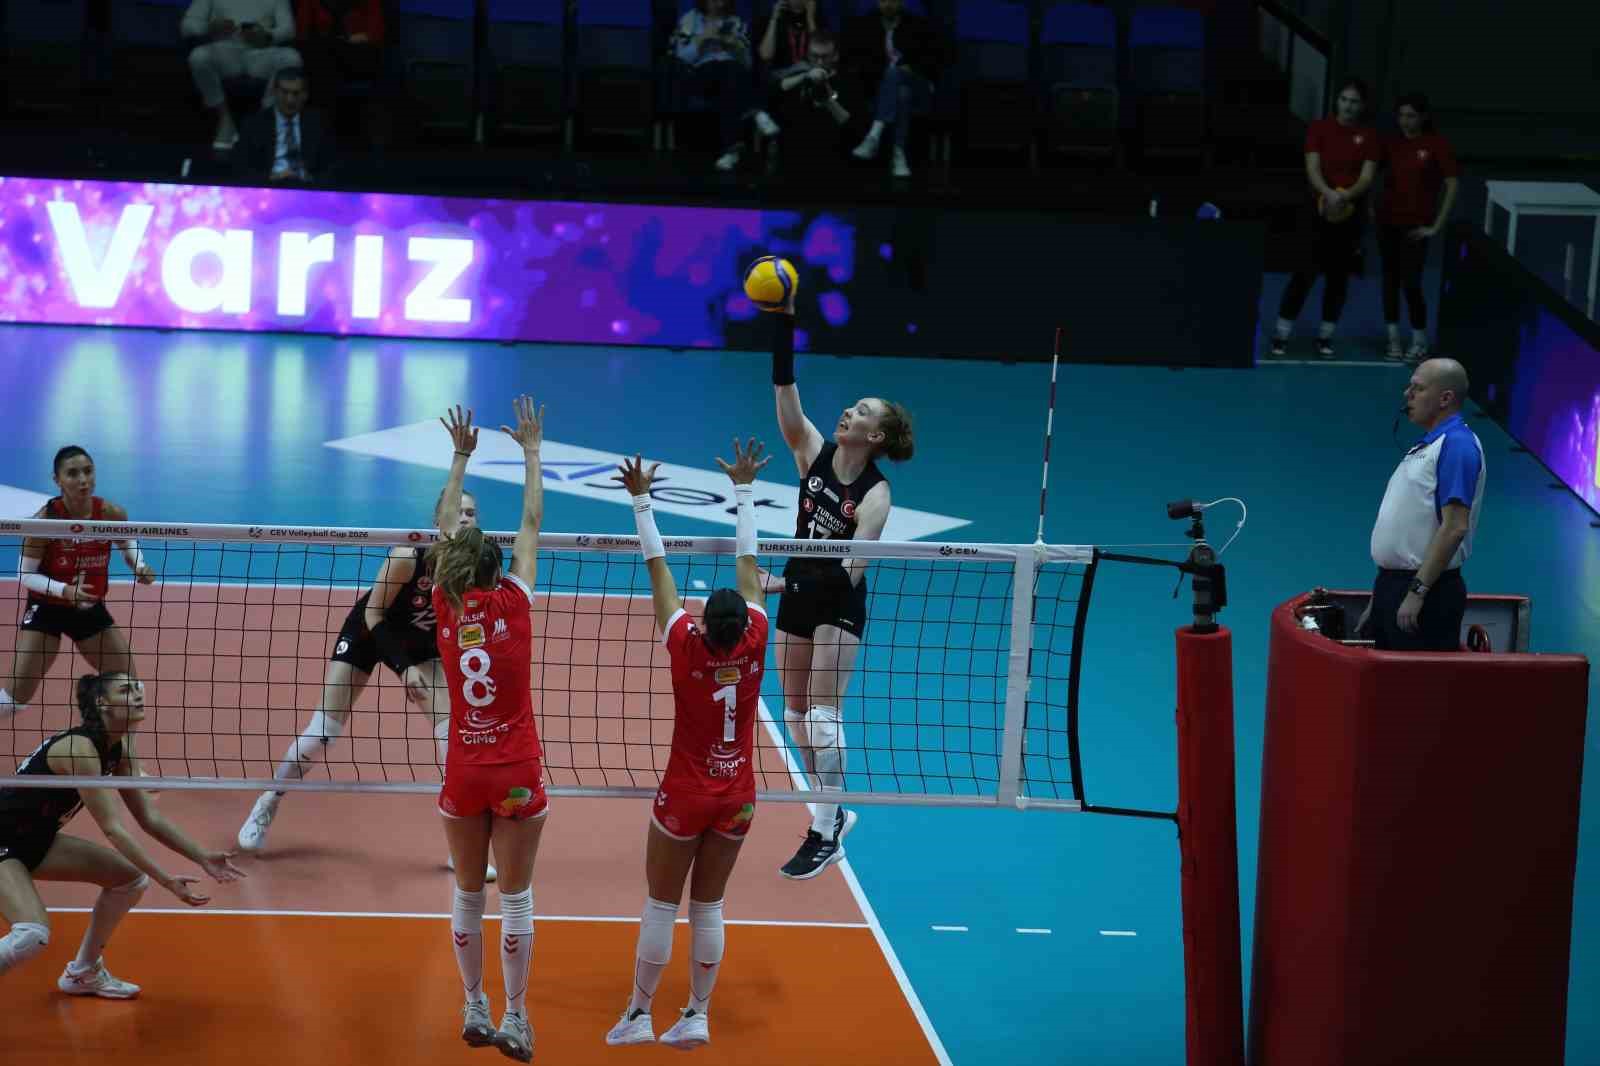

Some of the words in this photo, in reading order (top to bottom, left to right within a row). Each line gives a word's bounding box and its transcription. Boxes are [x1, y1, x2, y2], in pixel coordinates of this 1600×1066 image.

[816, 504, 847, 530] TURKISH
[91, 525, 138, 534] TURKISH
[139, 527, 188, 536] AIRLINES
[270, 528, 287, 536] CEV
[288, 529, 328, 540] Volleyball
[330, 530, 348, 539] Cup
[596, 537, 614, 545] CEV
[759, 543, 802, 552] TURKISH
[805, 544, 850, 553] AIRLINES
[460, 648, 497, 708] 8
[712, 685, 737, 743] 1
